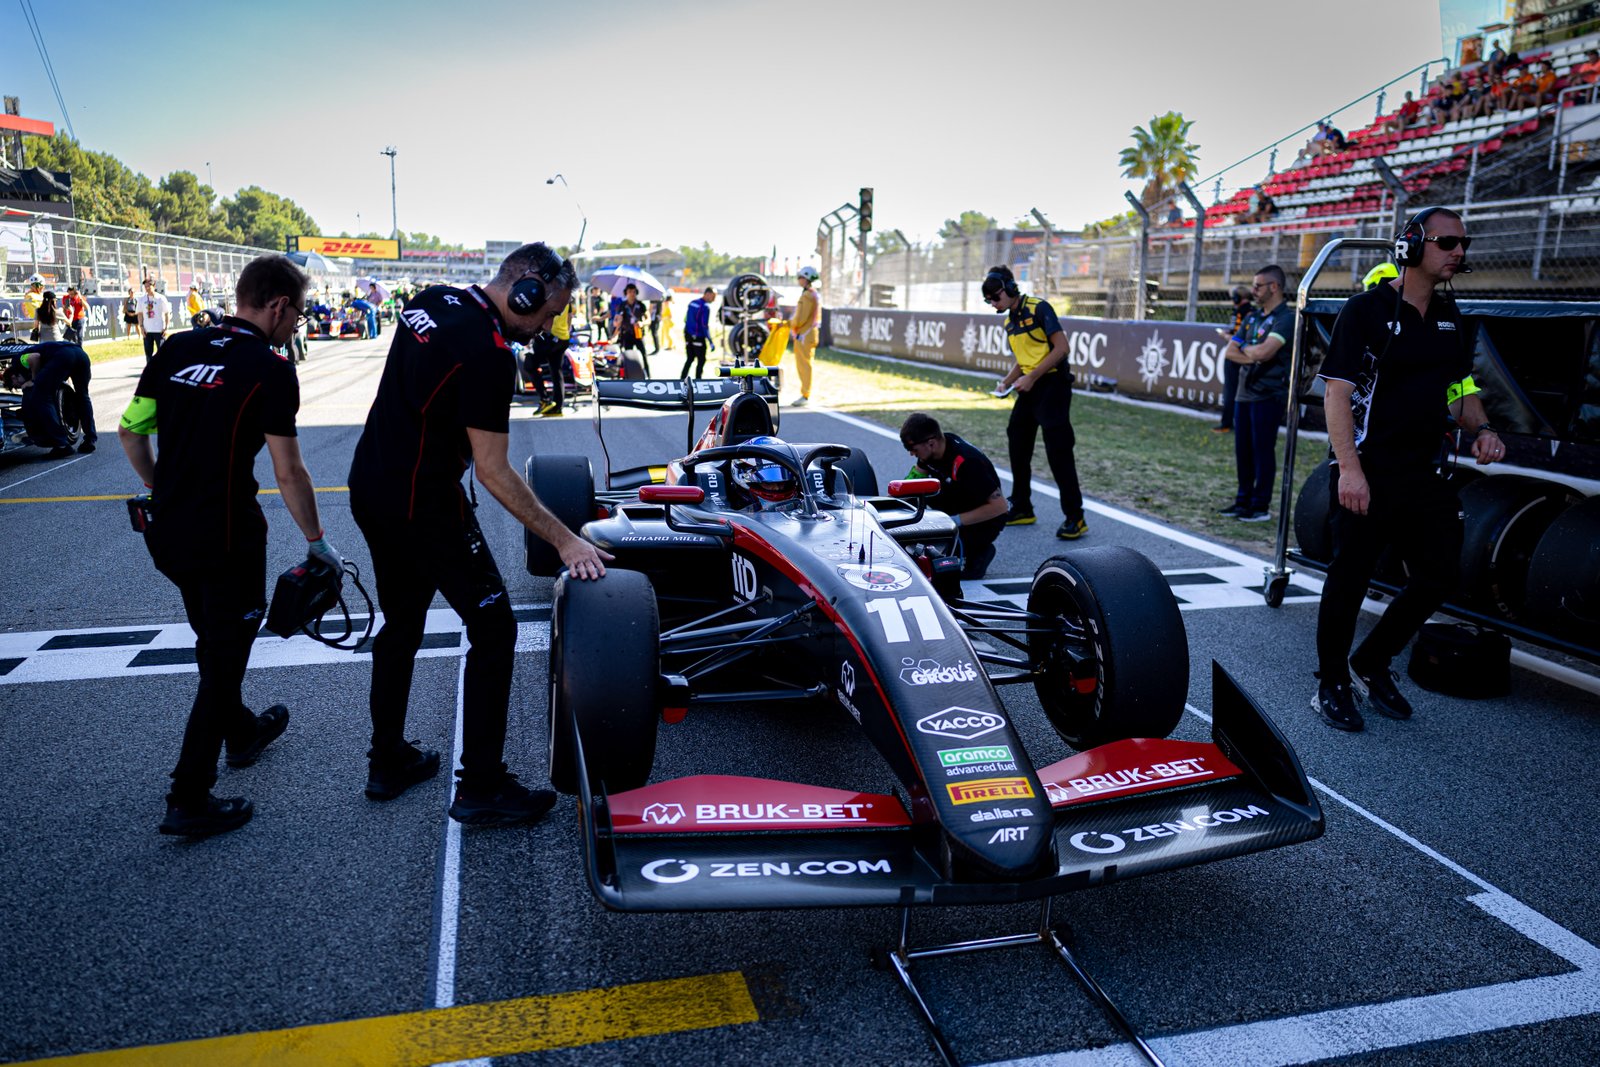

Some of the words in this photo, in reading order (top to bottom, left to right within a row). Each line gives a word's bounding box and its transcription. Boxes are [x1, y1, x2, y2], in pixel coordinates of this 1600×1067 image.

[322, 241, 375, 254] DHL
[1395, 241, 1409, 259] R
[87, 305, 108, 326] MSC
[402, 309, 438, 334] ART
[870, 317, 894, 342] MSC
[917, 320, 946, 348] MSC
[977, 324, 1013, 356] MSC
[1166, 385, 1225, 406] CRUISE
[869, 582, 904, 591] PZM
[865, 596, 945, 643] 11
[911, 669, 978, 685] GROUP
[927, 716, 996, 731] YACCO
[944, 749, 1008, 762] aramco
[946, 763, 997, 776] advanced
[996, 761, 1018, 772] fuel
[1068, 758, 1206, 793] BRUK-BET
[950, 780, 1030, 801] PIRELLI
[696, 803, 864, 819] BRUK-BET
[970, 808, 1034, 822] dallara
[1122, 804, 1270, 842] ZEN.COM
[988, 826, 1030, 844] ART
[710, 859, 892, 877] ZEN.COM
